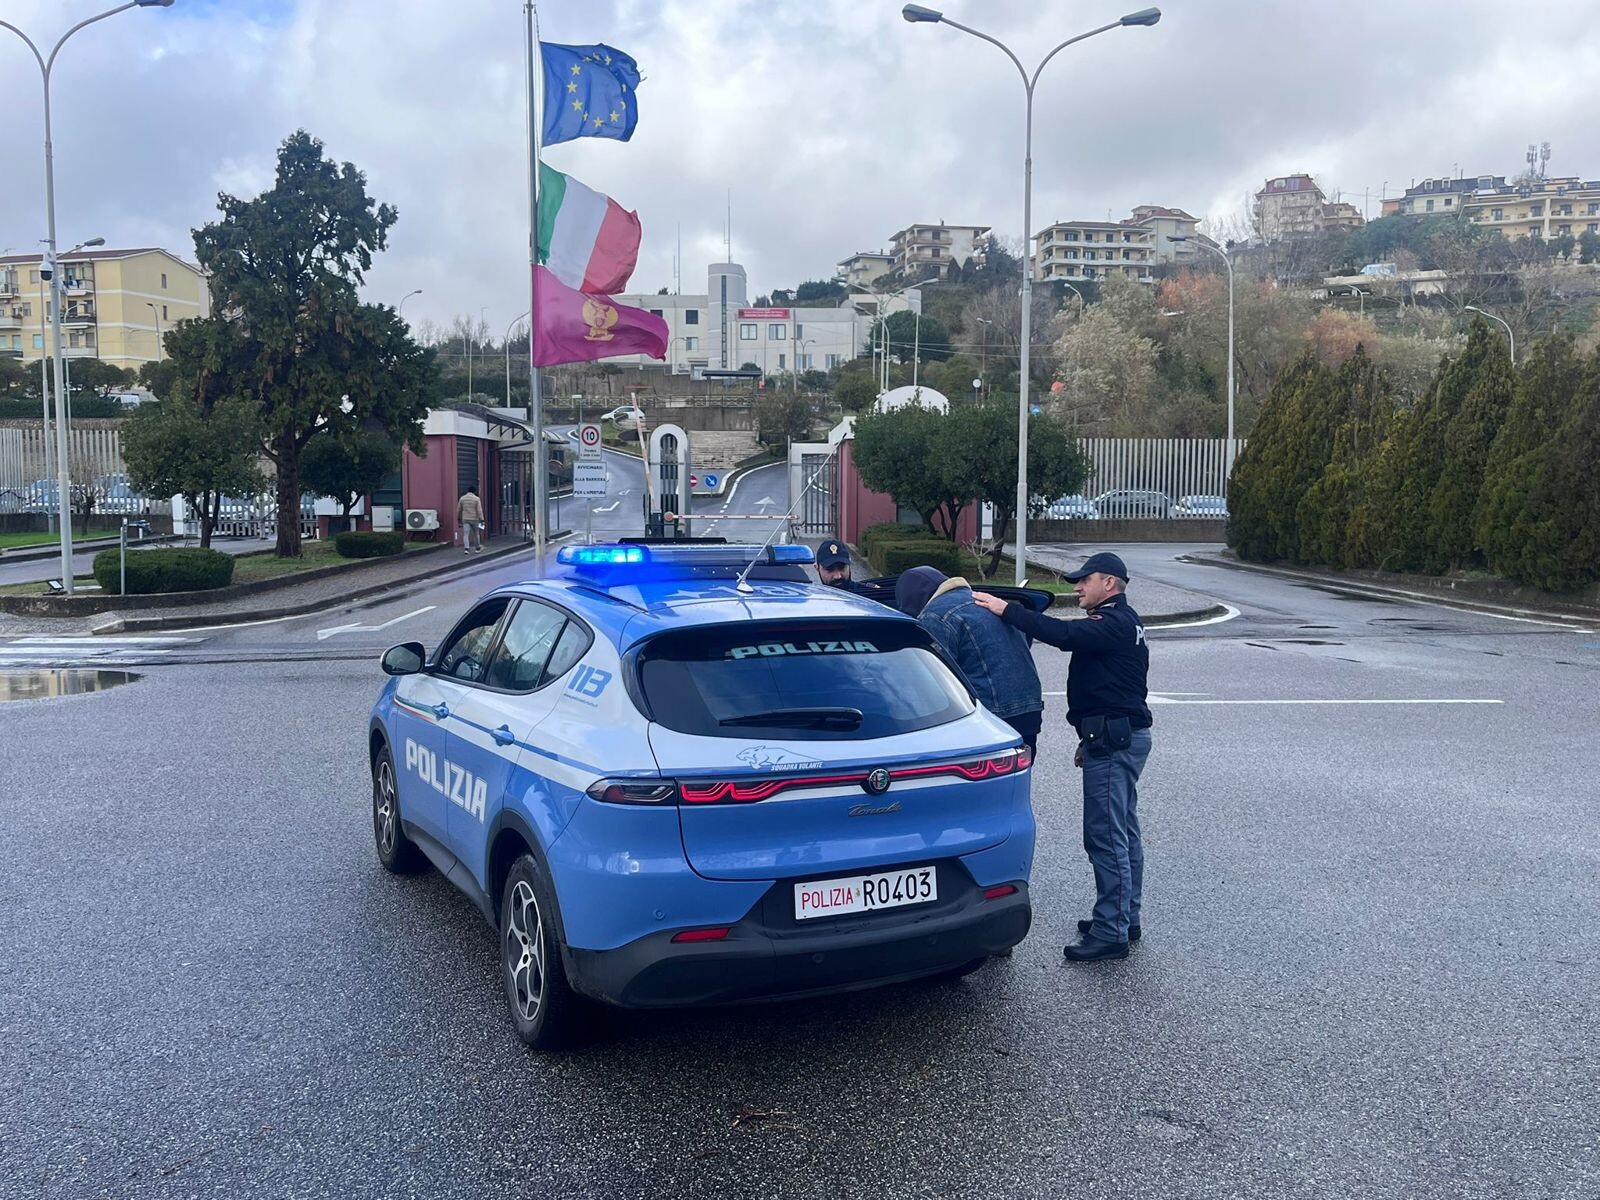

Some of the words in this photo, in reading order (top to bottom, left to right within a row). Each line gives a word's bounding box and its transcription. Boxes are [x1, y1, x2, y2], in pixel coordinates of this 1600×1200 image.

[586, 431, 595, 441] 10
[731, 641, 879, 659] POLIZIA
[567, 663, 612, 698] 113
[770, 763, 798, 771] SQUADRA
[798, 761, 823, 770] VOLANTE
[405, 736, 488, 825] POLIZIA
[801, 887, 854, 910] POLIZIA
[863, 872, 931, 907] R0403
